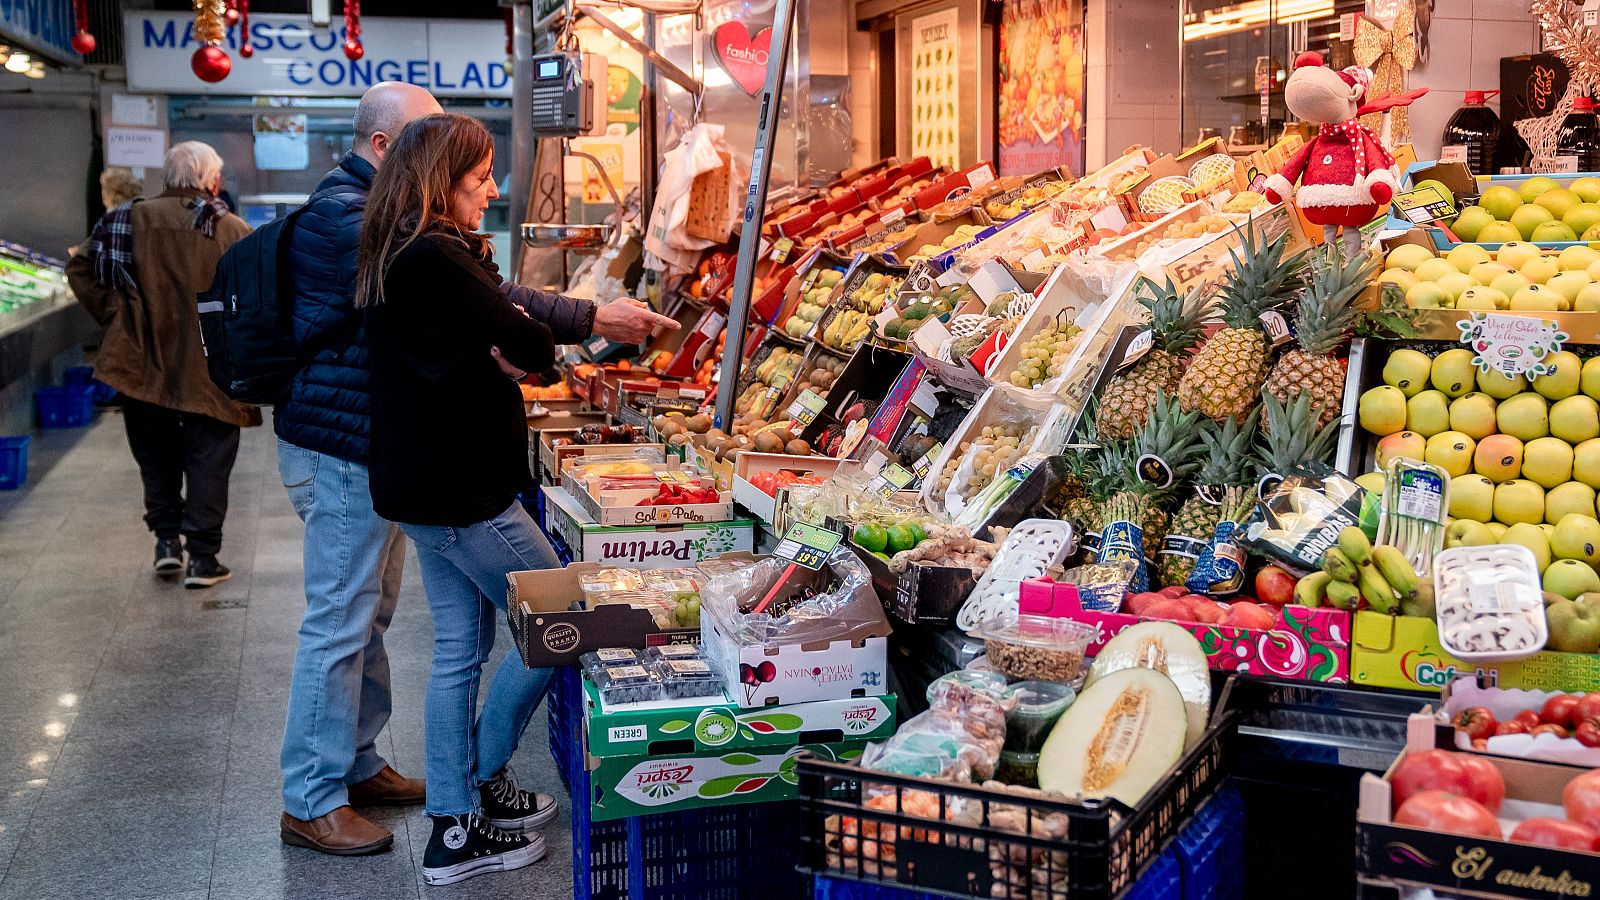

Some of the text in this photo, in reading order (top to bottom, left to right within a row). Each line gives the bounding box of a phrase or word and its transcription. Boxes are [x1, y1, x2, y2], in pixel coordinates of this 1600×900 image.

[634, 506, 704, 524] Sol Palos
[1298, 514, 1353, 564] ENDIBIAS
[602, 540, 692, 563] Perlim
[547, 629, 573, 640] QUALITY
[549, 635, 577, 647] BRAND
[1552, 665, 1564, 676] de
[1552, 677, 1564, 688] de
[841, 707, 877, 722] Zespri
[614, 728, 642, 739] GREEN
[634, 765, 694, 787] Zespri
[1451, 845, 1494, 881] El
